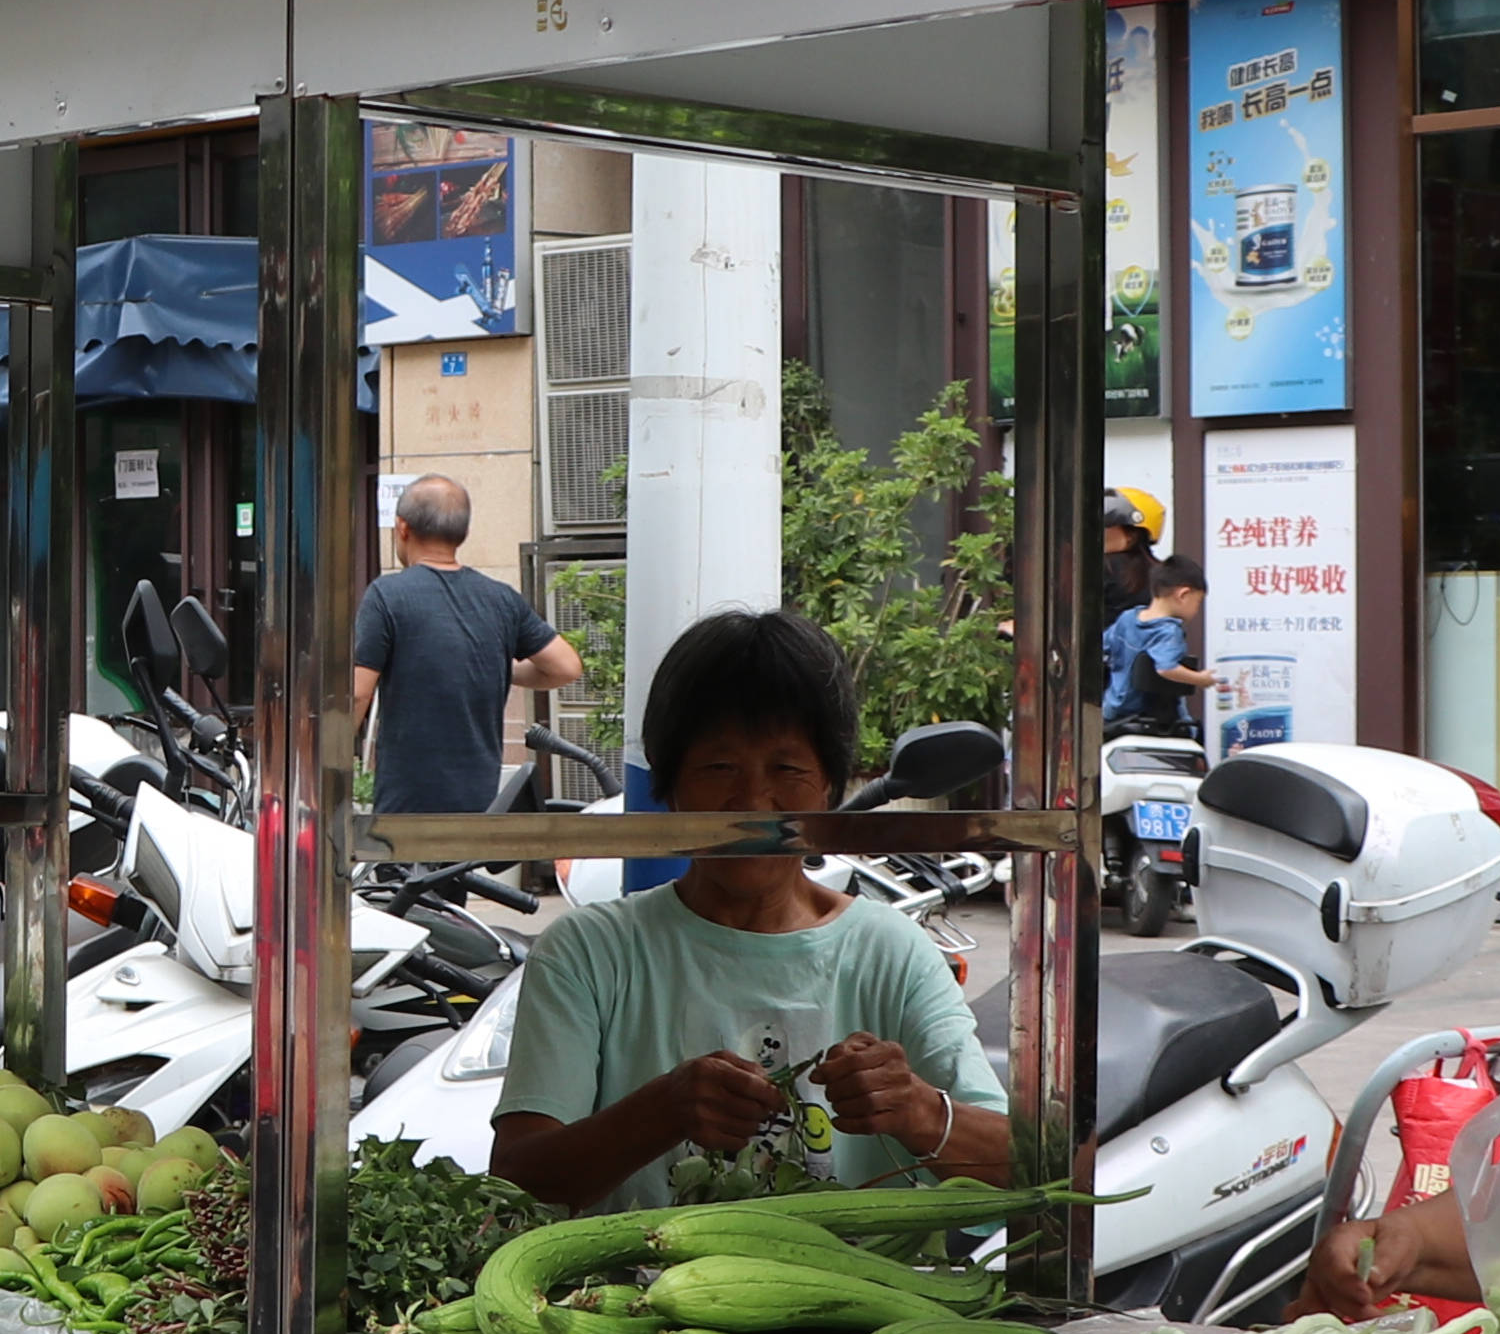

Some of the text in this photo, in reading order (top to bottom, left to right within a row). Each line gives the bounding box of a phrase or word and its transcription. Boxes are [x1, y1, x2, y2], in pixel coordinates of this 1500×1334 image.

[1242, 68, 1333, 119] 长高一点
[1218, 516, 1318, 548] 全纯营养
[1246, 565, 1347, 596] 更好吸收
[1224, 617, 1343, 632] 足量补充三个月看变化
